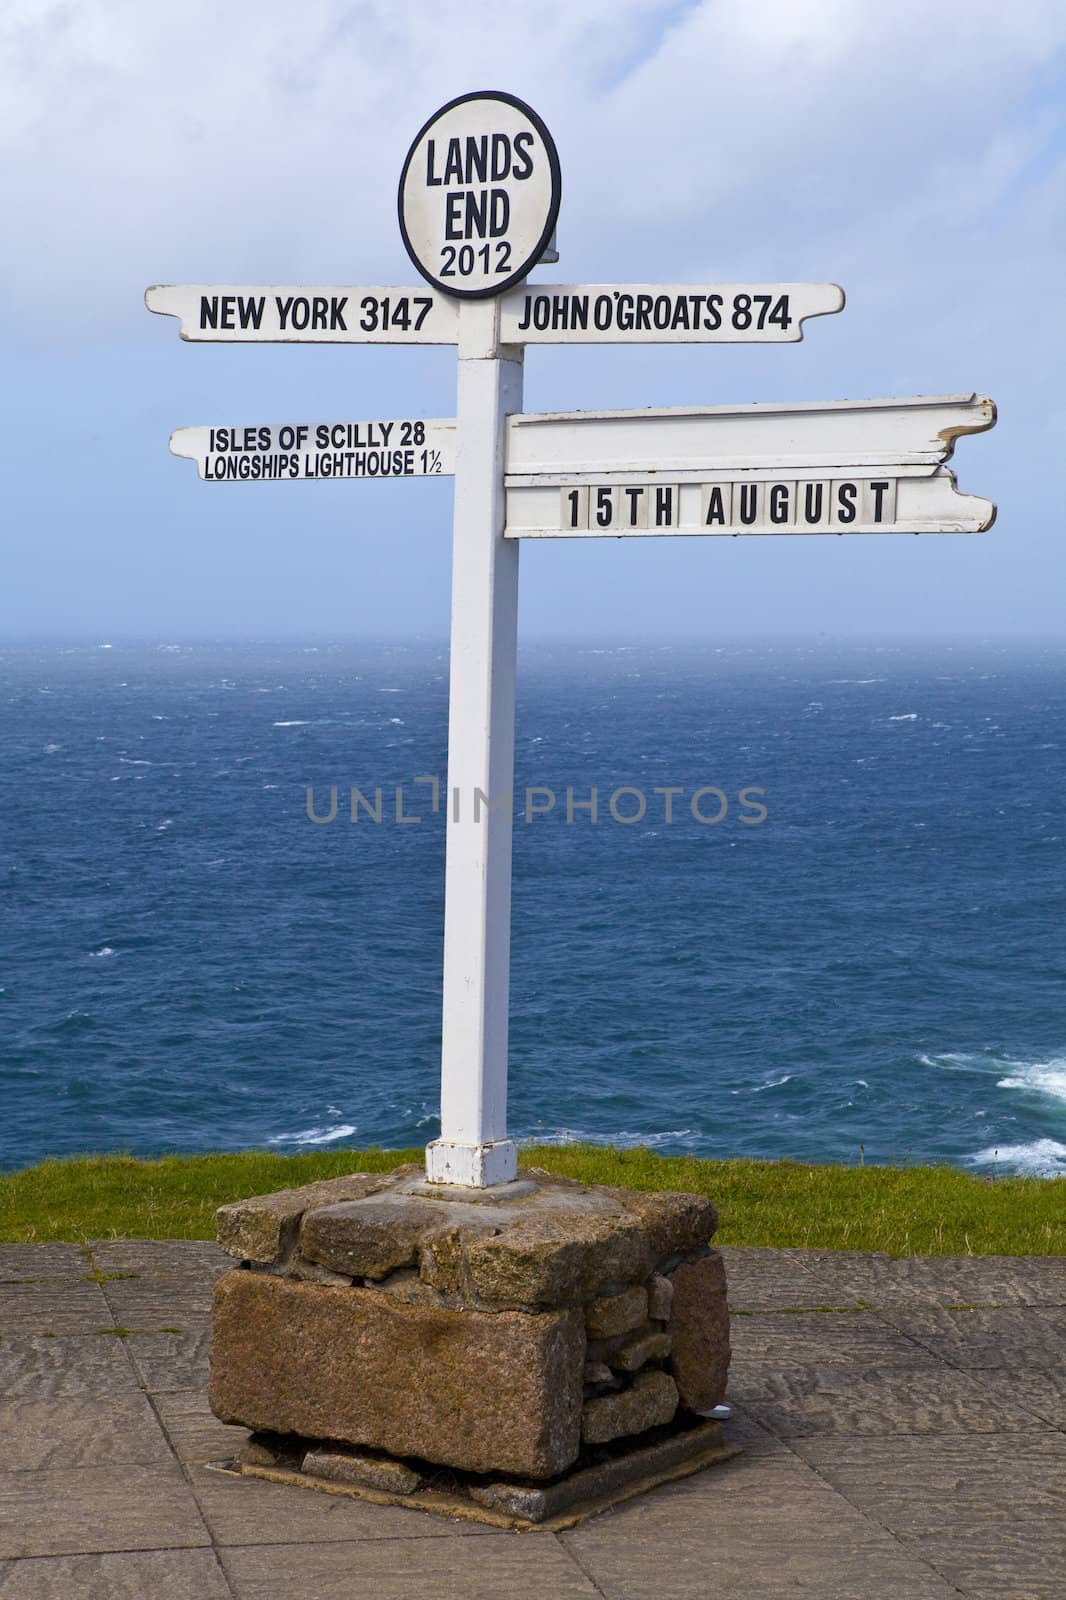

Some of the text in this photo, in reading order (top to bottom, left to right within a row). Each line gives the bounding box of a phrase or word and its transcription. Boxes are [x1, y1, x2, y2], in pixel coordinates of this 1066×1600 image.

[426, 132, 535, 187] LANDS
[445, 188, 510, 241] END
[439, 241, 512, 277] 2012
[200, 296, 434, 332] NEW YORK 3147
[518, 291, 792, 331] JOHN O'GROATS 874
[209, 421, 426, 453] ISLES OF SCILLY 28
[204, 454, 300, 480] LONGSHIPS
[304, 450, 415, 477] LIGHTHOUSE
[567, 481, 890, 527] 15TH AUGUST
